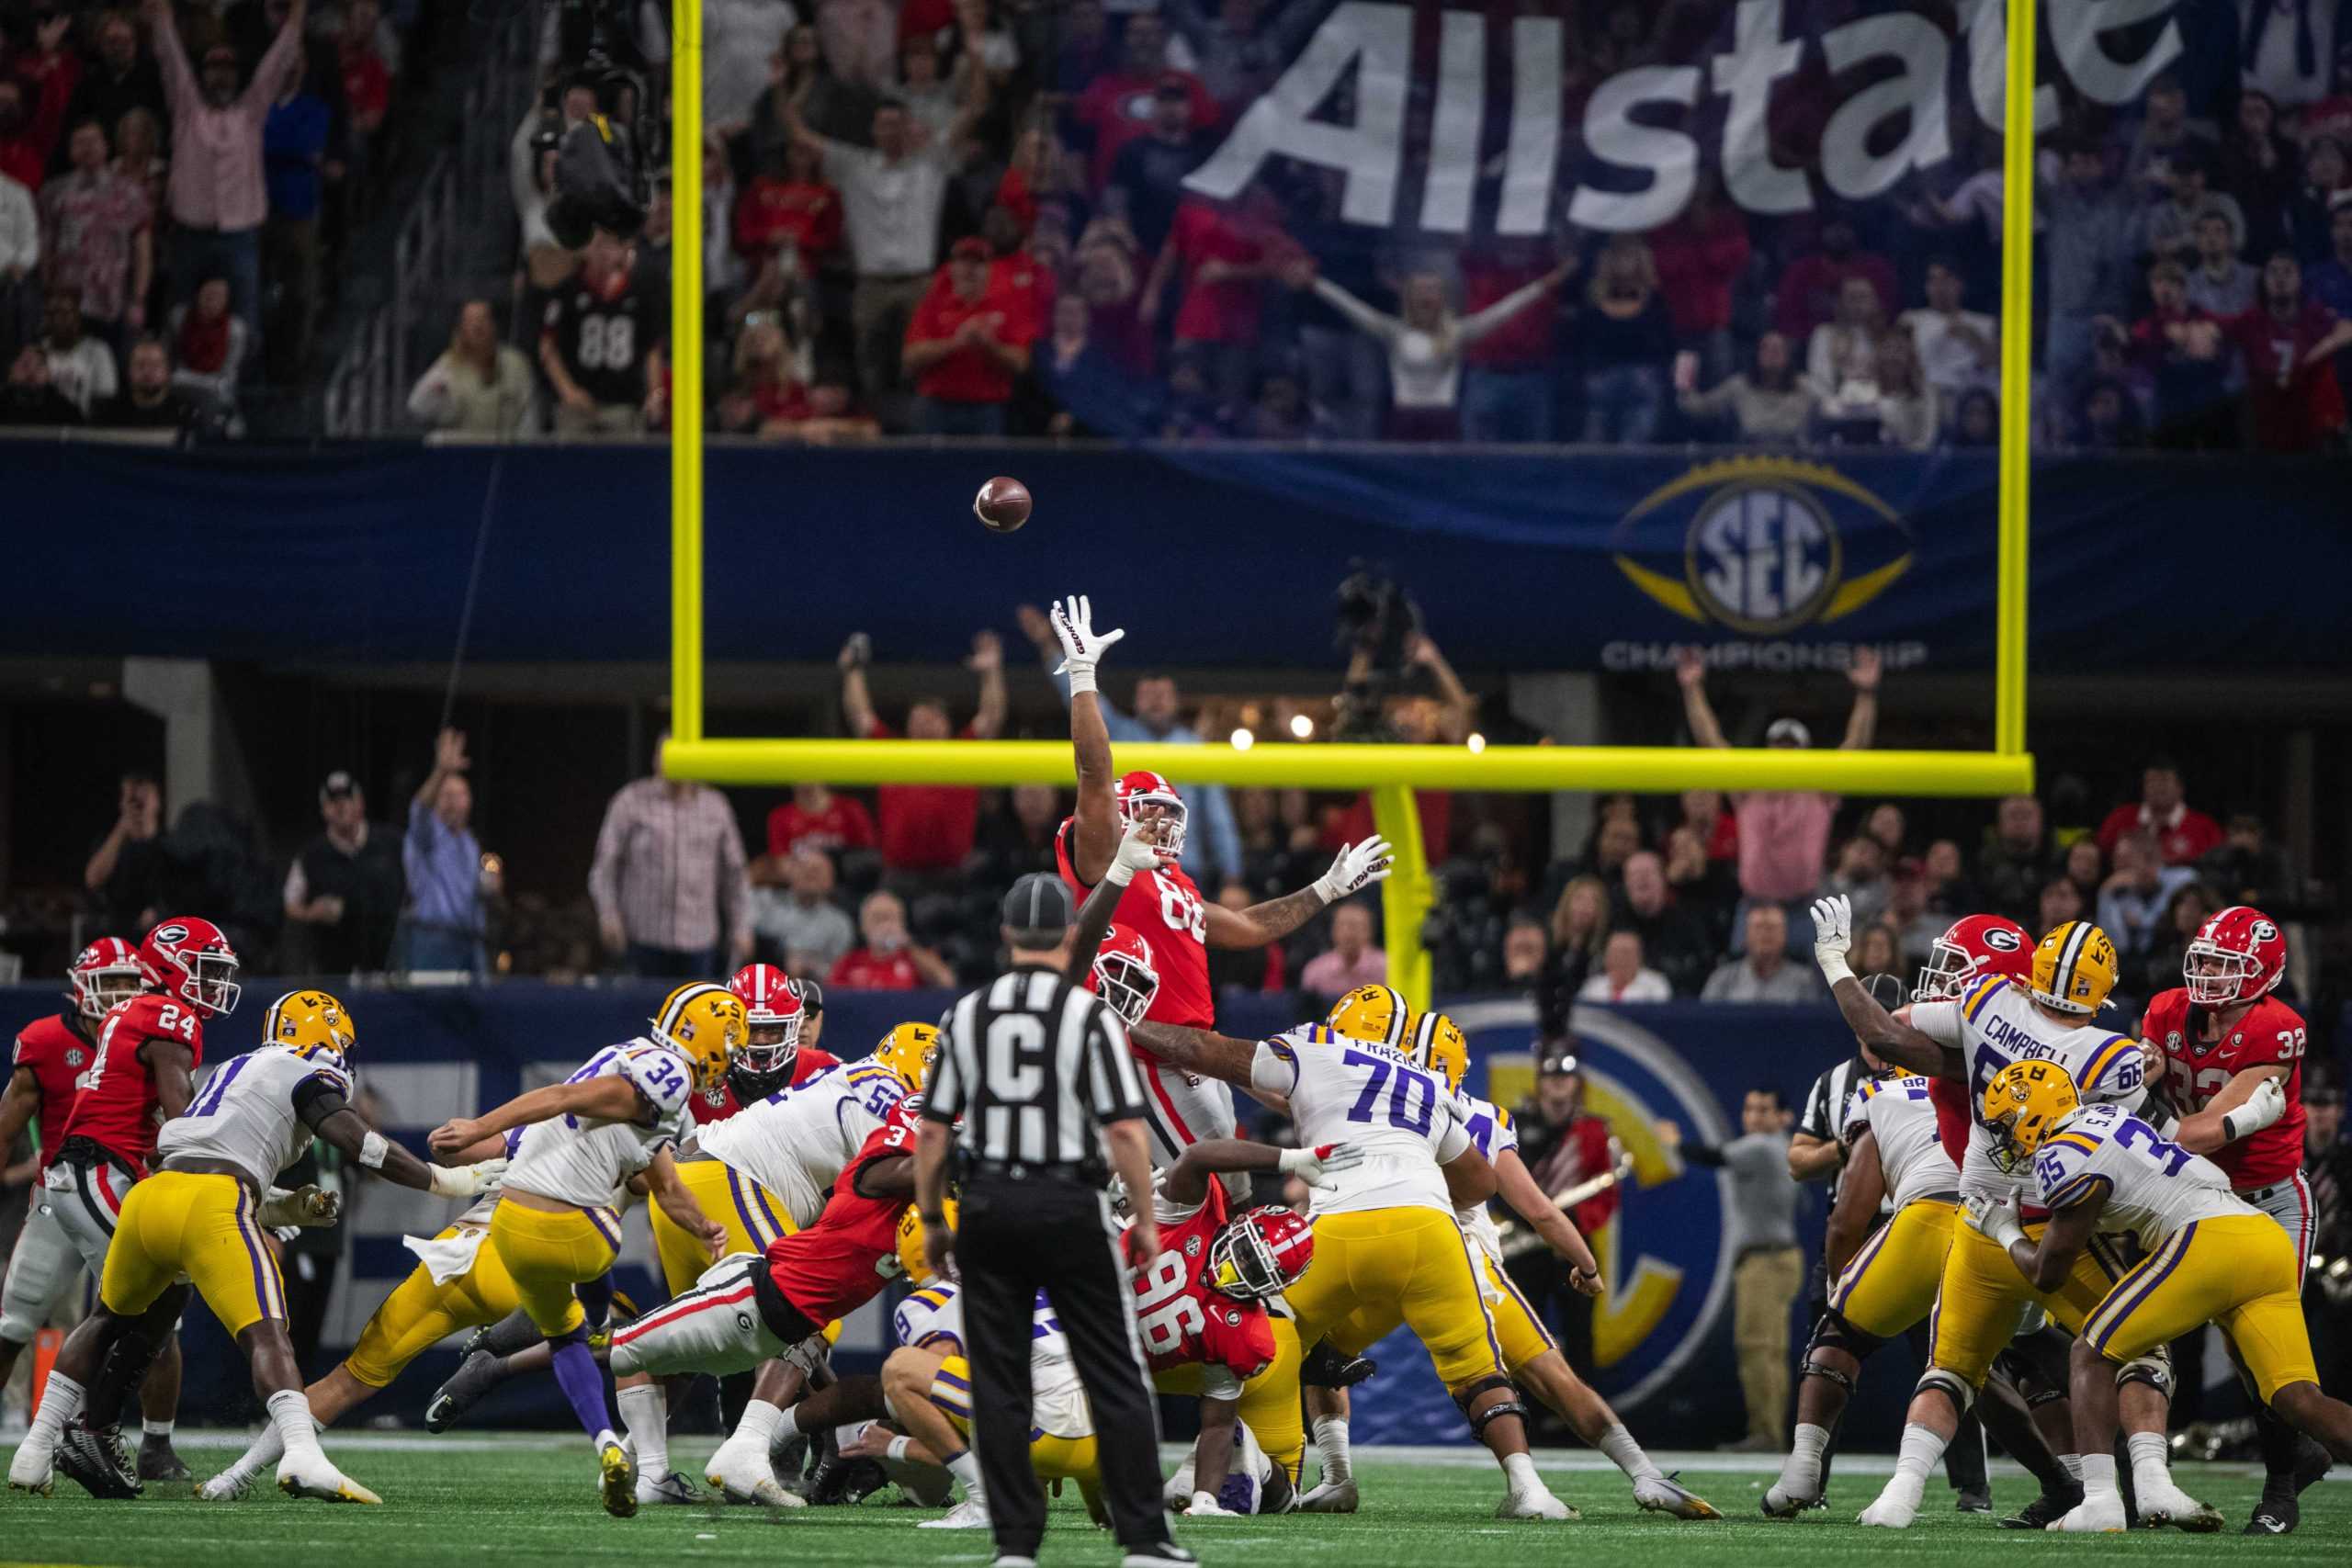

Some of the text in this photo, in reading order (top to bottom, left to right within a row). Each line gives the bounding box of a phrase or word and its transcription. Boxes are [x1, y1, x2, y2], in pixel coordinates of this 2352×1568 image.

[578, 313, 635, 370] 88
[1702, 491, 1824, 618] SEC
[1601, 641, 1928, 672] CHAMPIONSIP
[158, 1004, 197, 1041] 24
[1984, 1014, 2068, 1066] CAMPBELL
[2277, 1027, 2307, 1059] 32
[645, 1057, 684, 1100] 34
[986, 1013, 1046, 1101] C
[2117, 1058, 2142, 1089] 66
[1343, 1049, 1435, 1139] 70
[1902, 1077, 1927, 1088] BR
[2036, 1150, 2066, 1193] 35
[1132, 1249, 1205, 1355] 96
